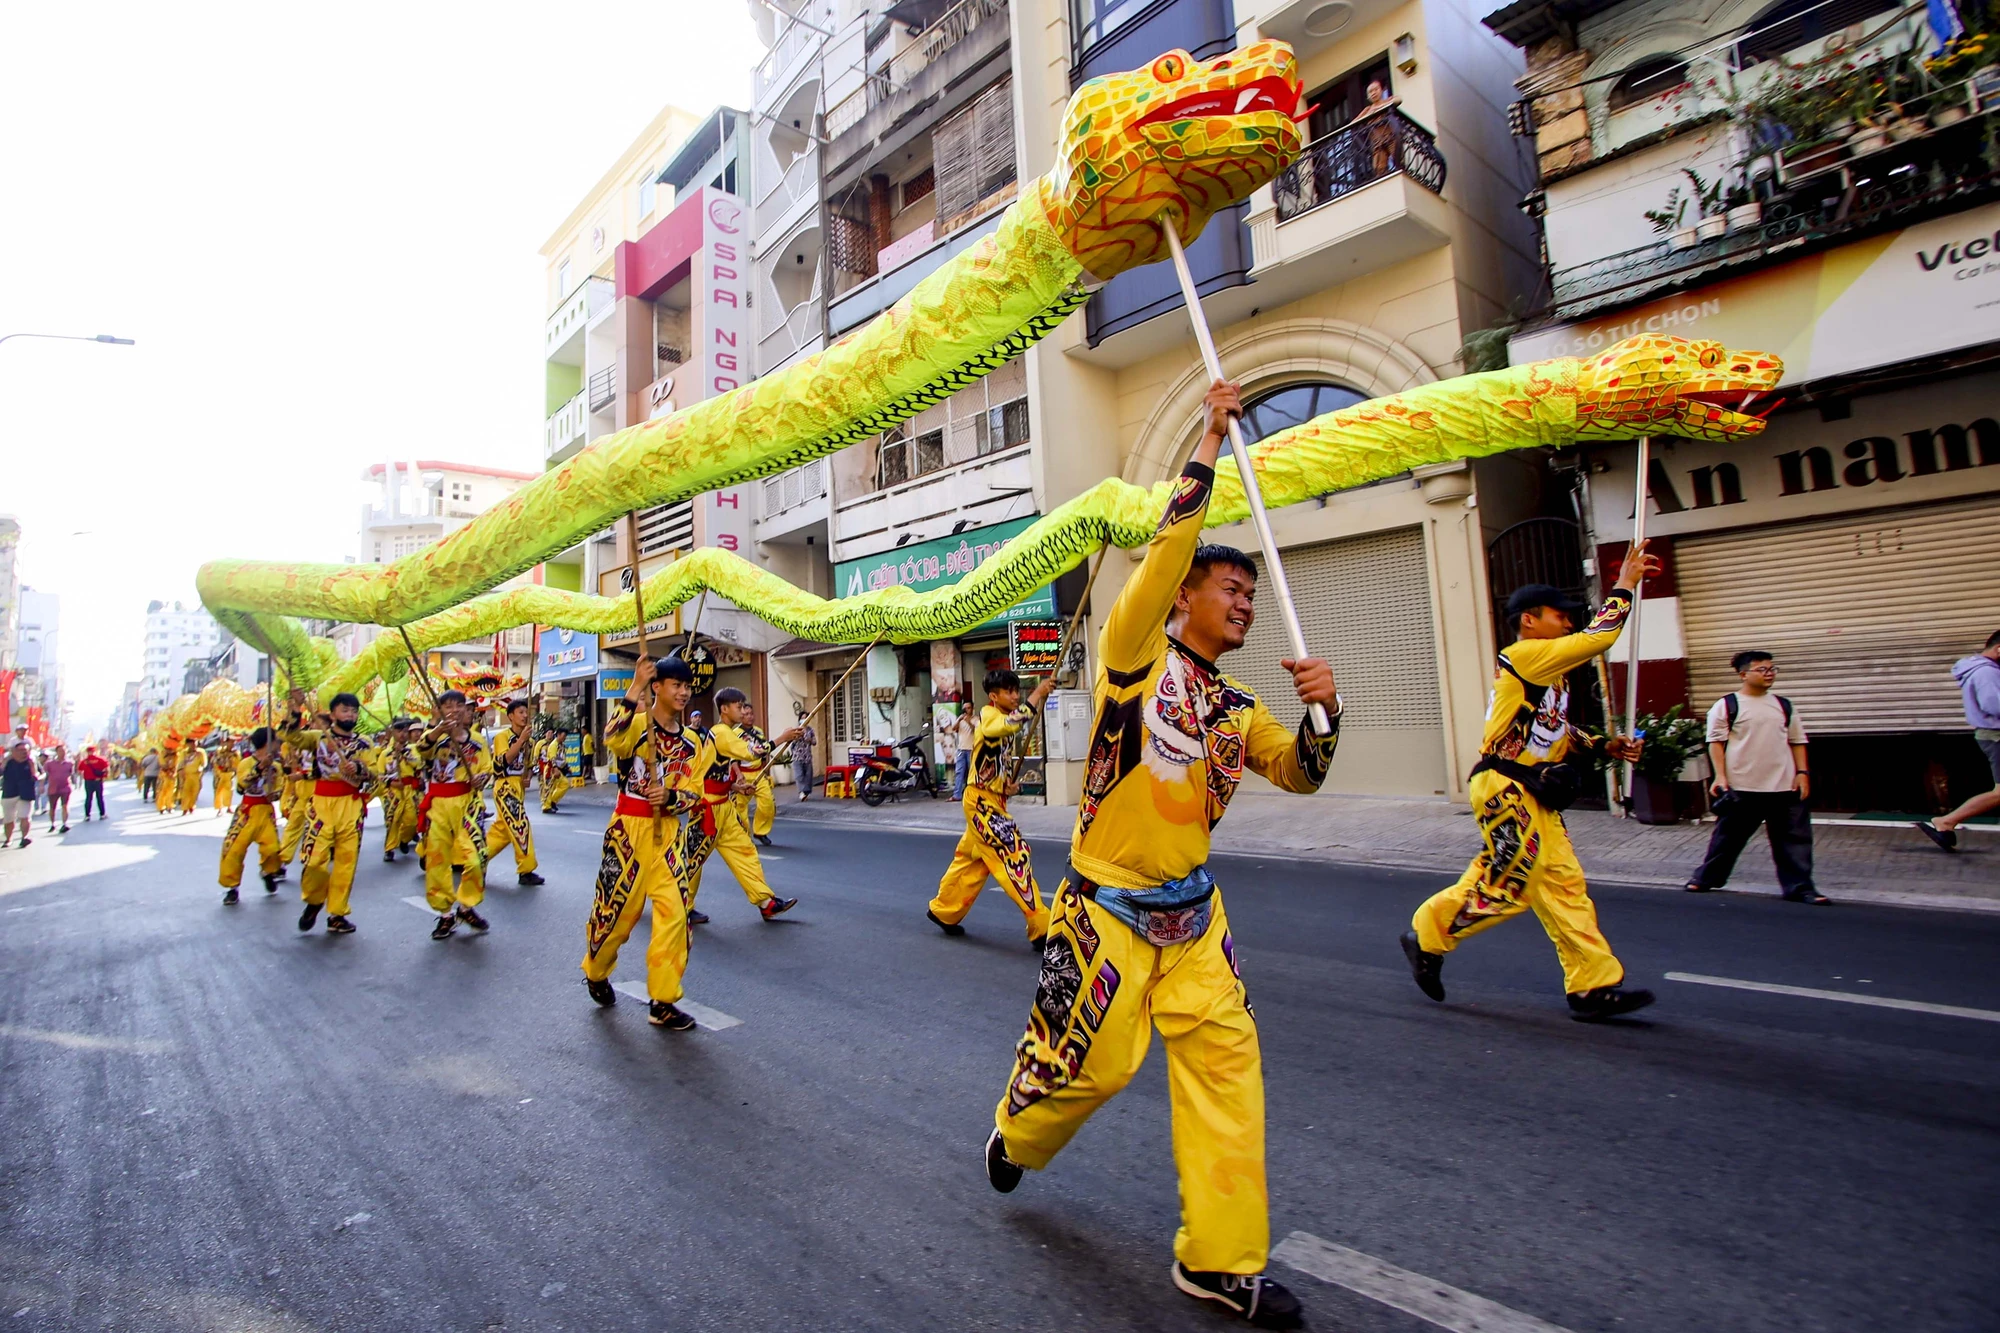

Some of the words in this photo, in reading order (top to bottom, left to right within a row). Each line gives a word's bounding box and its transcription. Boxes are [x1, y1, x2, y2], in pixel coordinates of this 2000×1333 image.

[714, 242, 738, 309] SPA
[1645, 298, 1721, 332] CHỌN
[714, 328, 738, 393] NGO
[1627, 456, 1747, 520] An
[1773, 417, 2000, 498] nam
[717, 533, 738, 551] 3
[899, 555, 923, 586] SÓC
[923, 555, 940, 581] DA
[697, 663, 714, 675] ANH
